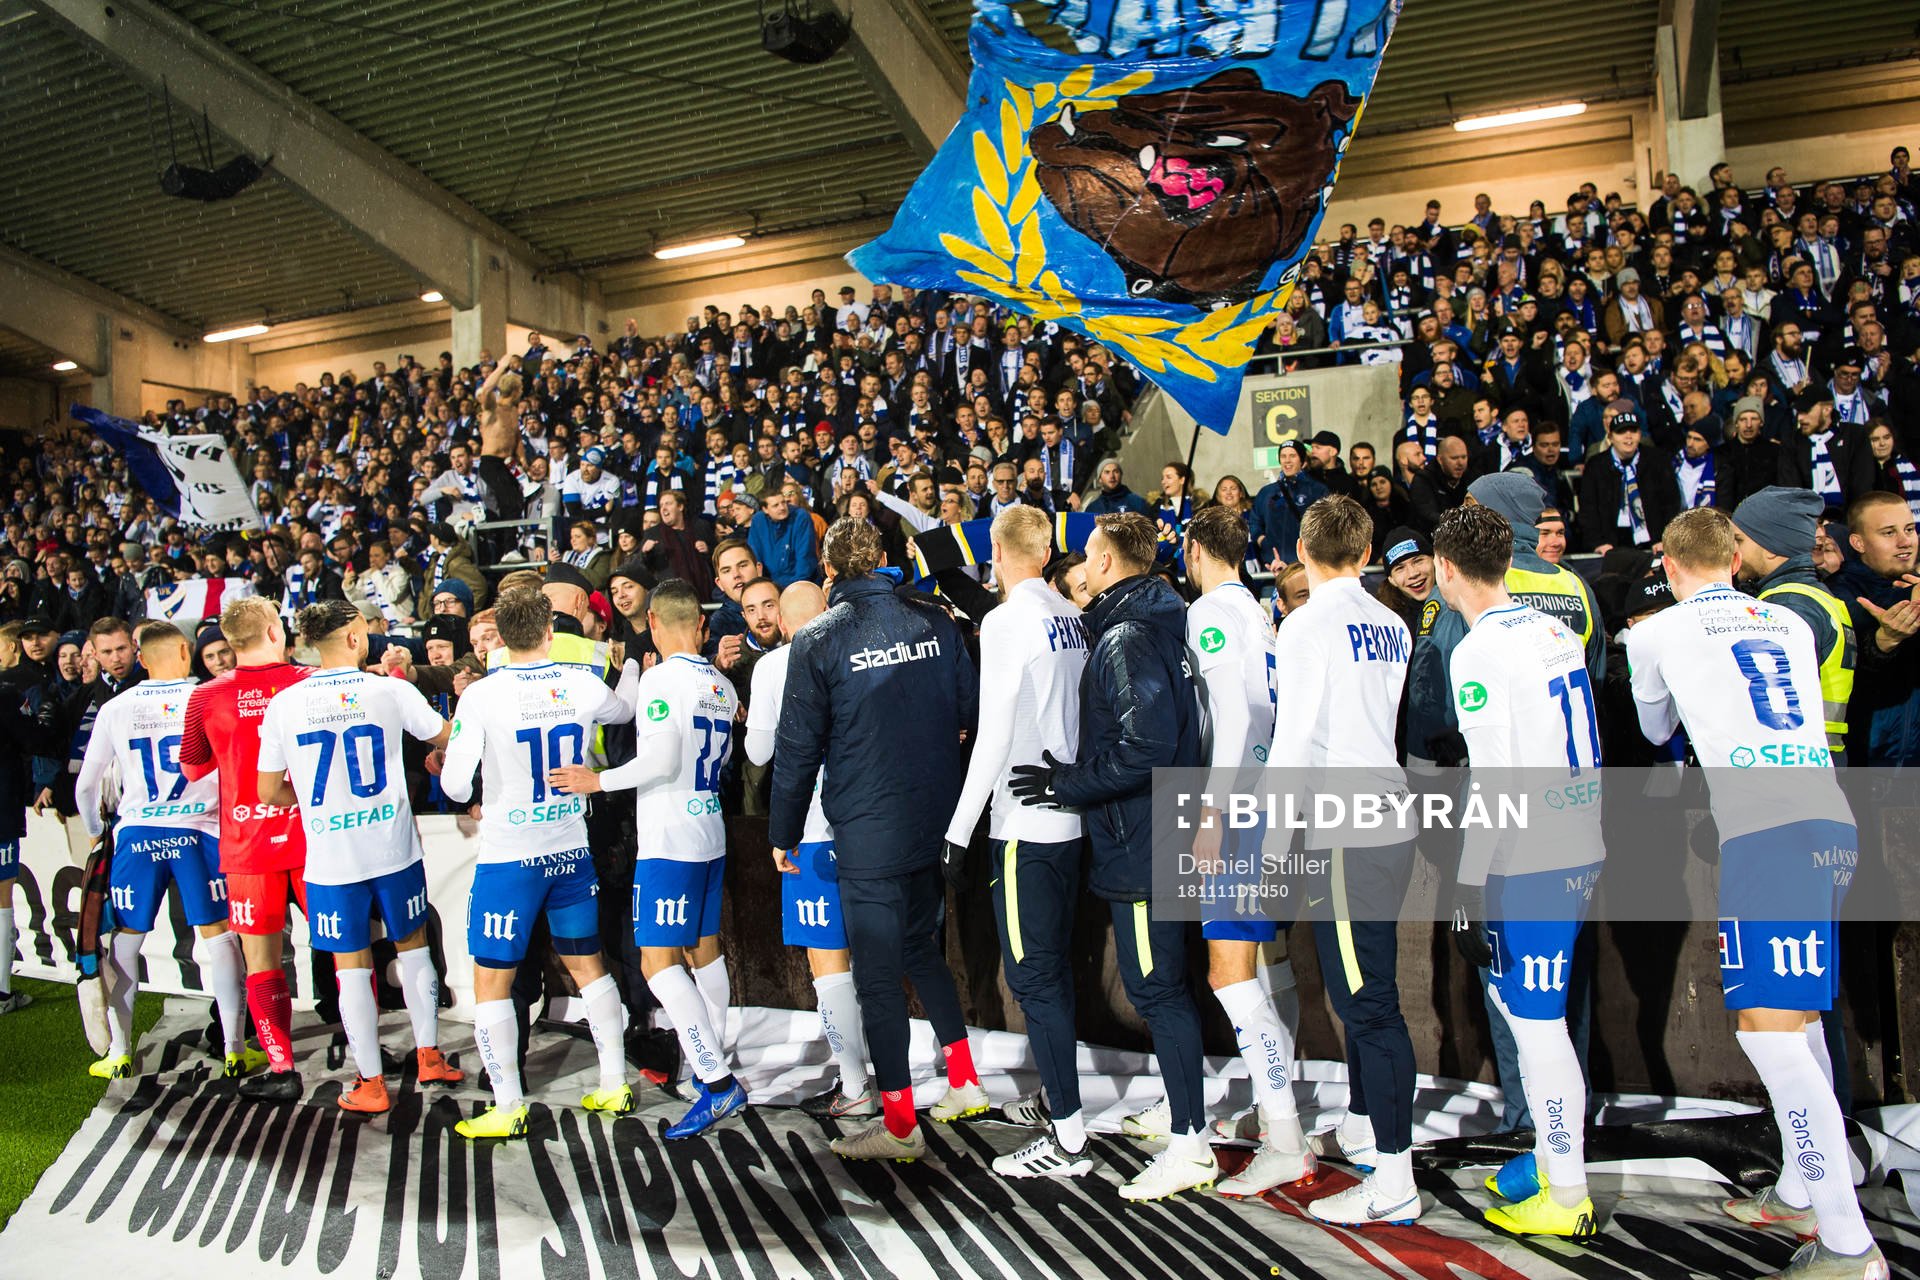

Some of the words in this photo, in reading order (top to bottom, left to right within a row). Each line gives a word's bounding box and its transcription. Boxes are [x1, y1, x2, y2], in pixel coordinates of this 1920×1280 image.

[1255, 387, 1307, 403] SEKTION
[1266, 404, 1298, 445] C
[1042, 615, 1090, 652] PEKIN
[1347, 623, 1409, 663] PEKING
[850, 640, 941, 672] stadium
[237, 688, 263, 700] Let's
[1731, 638, 1804, 731] 8
[237, 697, 271, 709] create
[1548, 668, 1602, 779] 11
[296, 723, 388, 807] 70
[516, 722, 584, 803] 10
[1760, 744, 1830, 767] SEFAB
[141, 802, 206, 819] SEFAB
[329, 803, 395, 831] SEFAB
[531, 797, 581, 823] SEFAB
[131, 835, 199, 854] MÅNSSON
[151, 848, 181, 862] RÖR
[544, 861, 576, 878] RÖR
[231, 898, 257, 926] nt
[406, 887, 427, 920] nt
[655, 893, 689, 926] nt
[796, 895, 830, 927] nt
[317, 910, 343, 940] nt
[482, 908, 519, 941] nt
[1768, 930, 1826, 978] nt
[1521, 950, 1567, 993] nt
[1546, 1096, 1564, 1131] suez
[1788, 1107, 1815, 1150] suez
